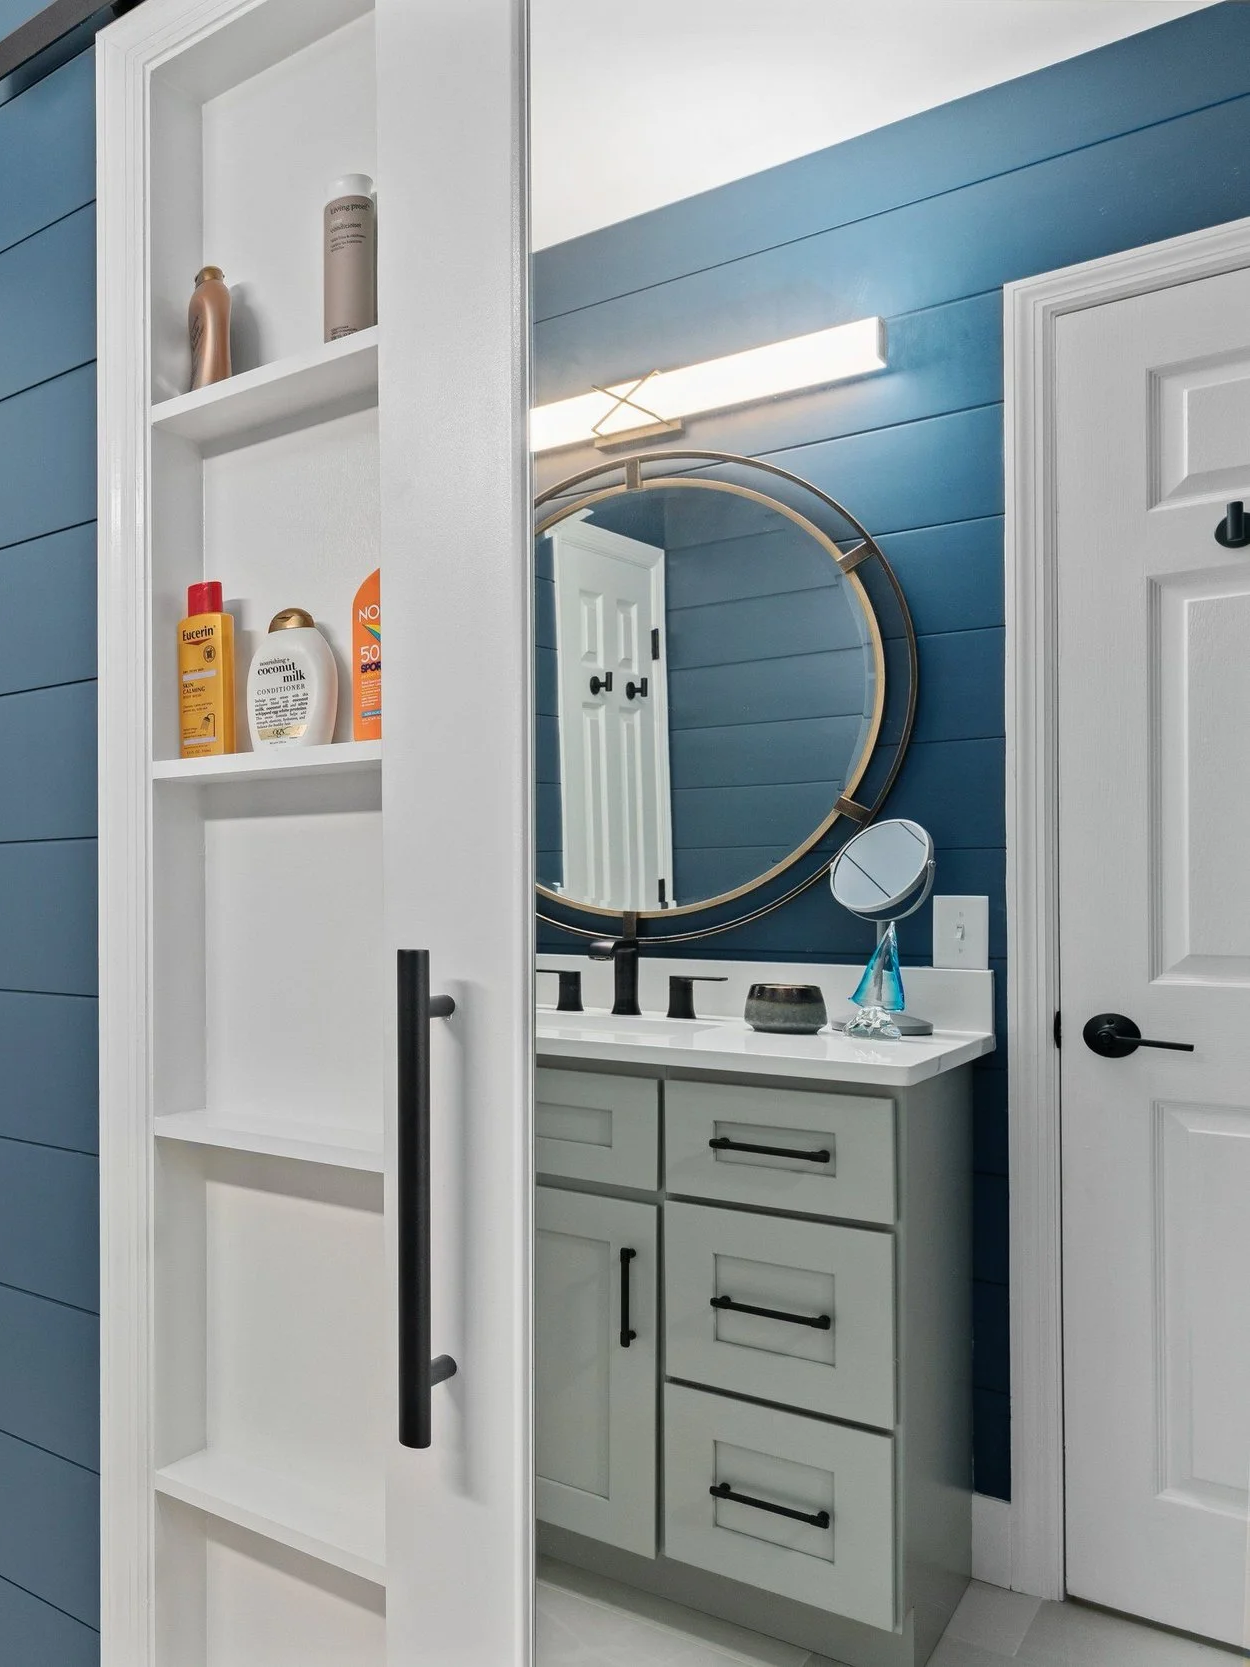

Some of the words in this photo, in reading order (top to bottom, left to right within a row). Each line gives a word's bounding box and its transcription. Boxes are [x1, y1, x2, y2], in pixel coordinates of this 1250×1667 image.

[182, 625, 214, 642] Eucerin
[360, 644, 380, 663] 50
[258, 662, 295, 675] coconut
[283, 670, 305, 682] milk
[182, 686, 206, 695] CALMING
[257, 684, 305, 695] CONDITIONER
